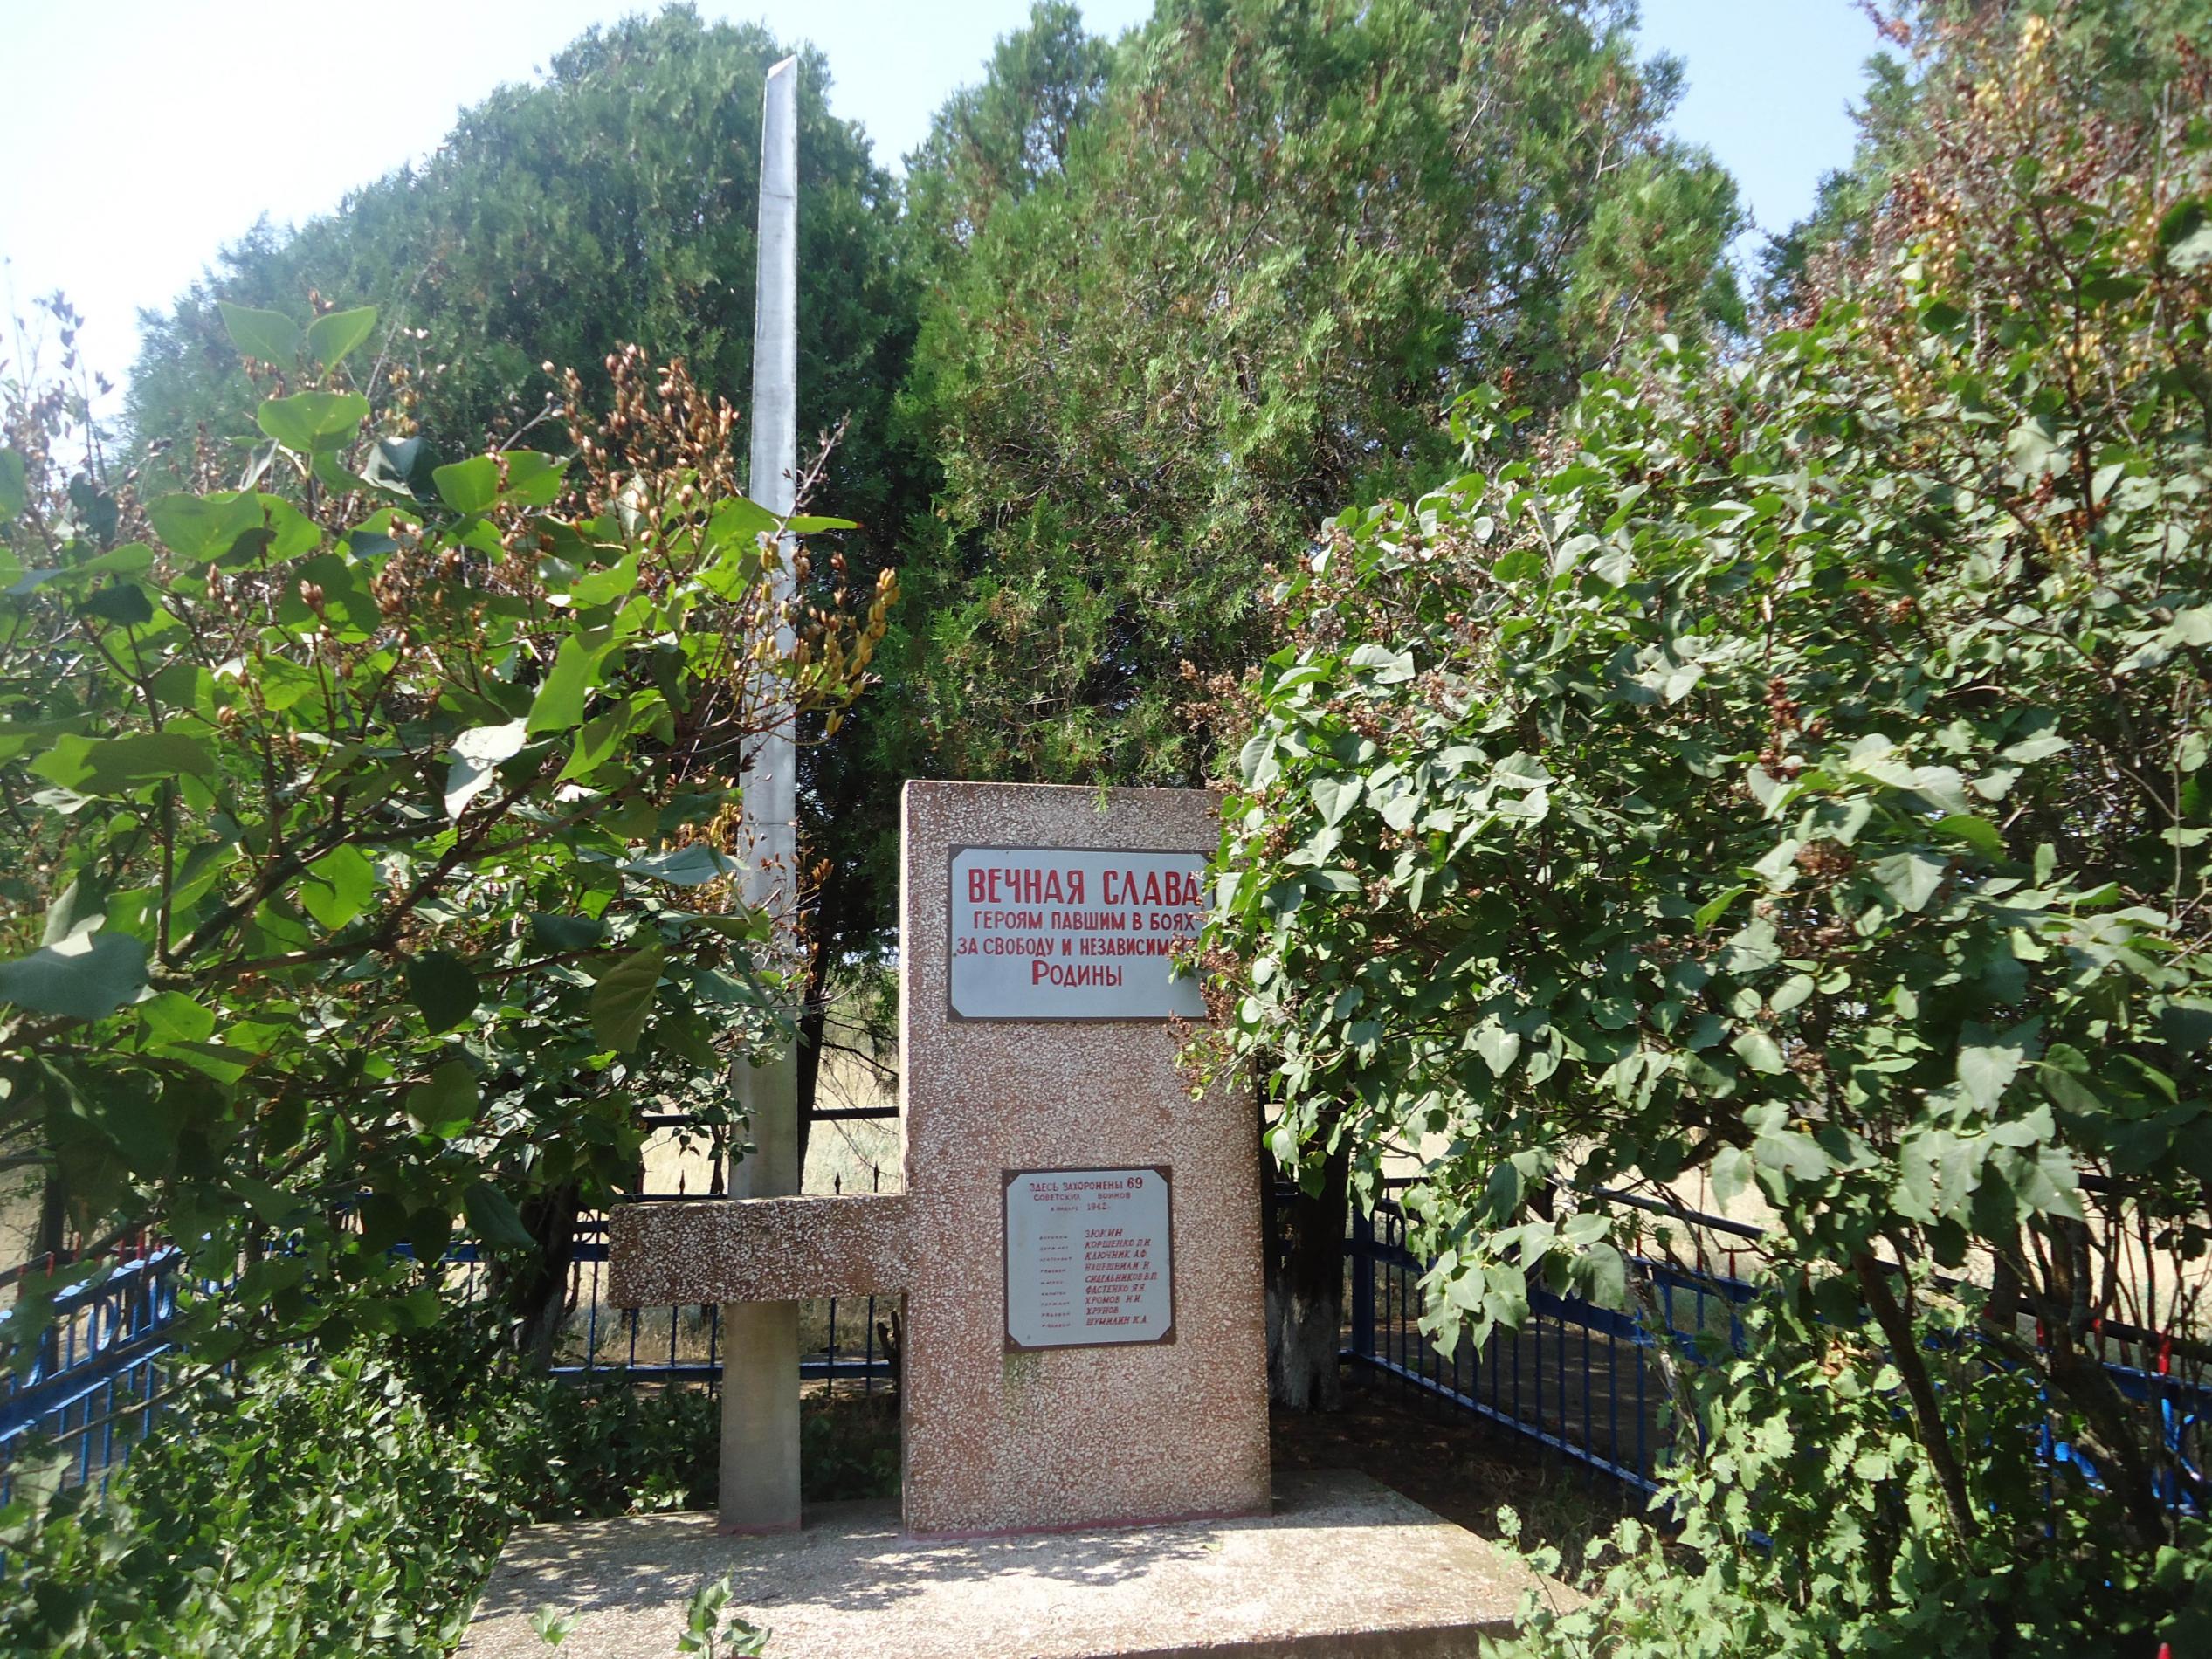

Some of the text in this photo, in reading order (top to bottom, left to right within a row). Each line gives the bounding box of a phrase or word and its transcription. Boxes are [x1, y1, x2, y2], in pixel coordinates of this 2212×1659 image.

[968, 868, 1201, 906] ВЕЧНАЯ СЛАВА
[974, 911, 1196, 931] ГЕРОЯМ ПАВШИМ В БОЯХ
[956, 937, 1200, 957] ЗА СВОБОДУ И НЕЗАВИСИМ
[1029, 1176, 1143, 1192] ЗДЕСЬ ЗАХОРОНЕНЫ 69
